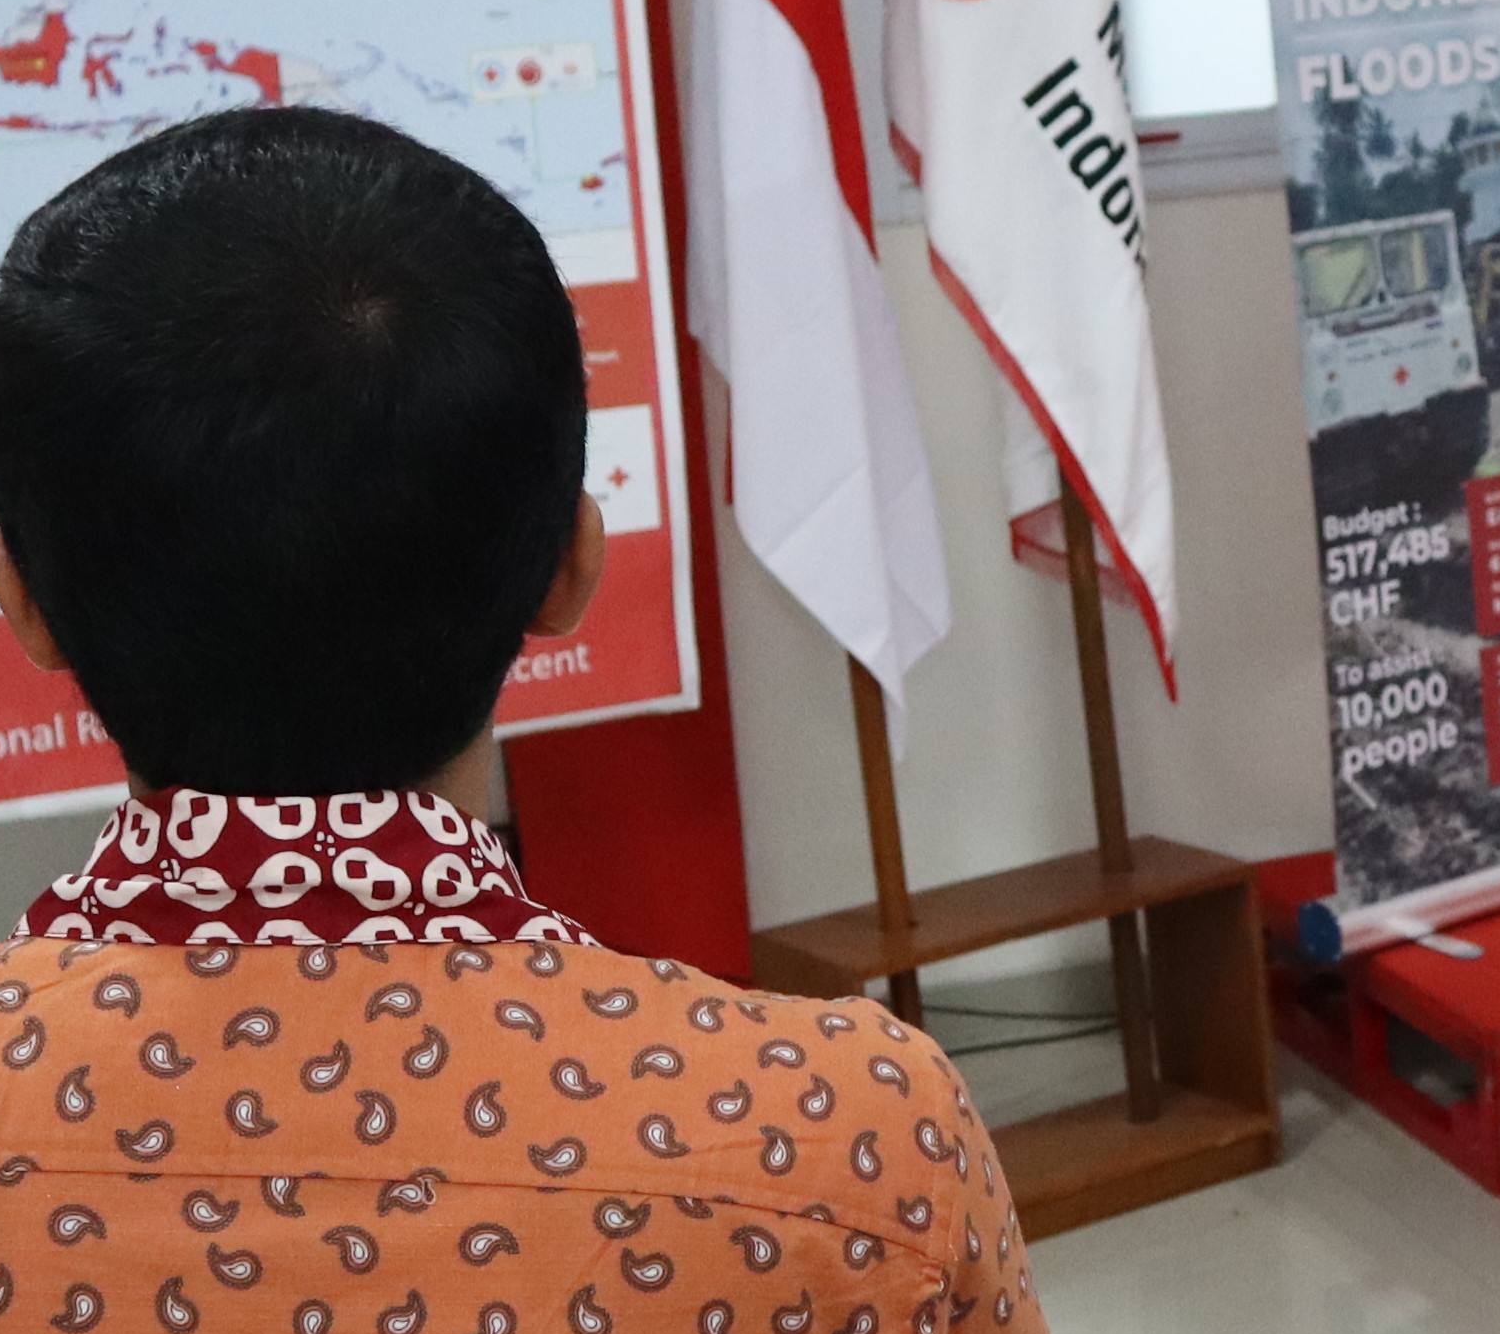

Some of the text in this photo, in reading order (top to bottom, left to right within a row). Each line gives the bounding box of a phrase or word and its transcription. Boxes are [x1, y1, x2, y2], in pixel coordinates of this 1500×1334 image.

[1322, 503, 1410, 542] Budget
[1324, 523, 1451, 584] 517,485
[1329, 578, 1402, 626] CHF
[1337, 671, 1449, 730] 10,000
[1341, 717, 1460, 779] people
